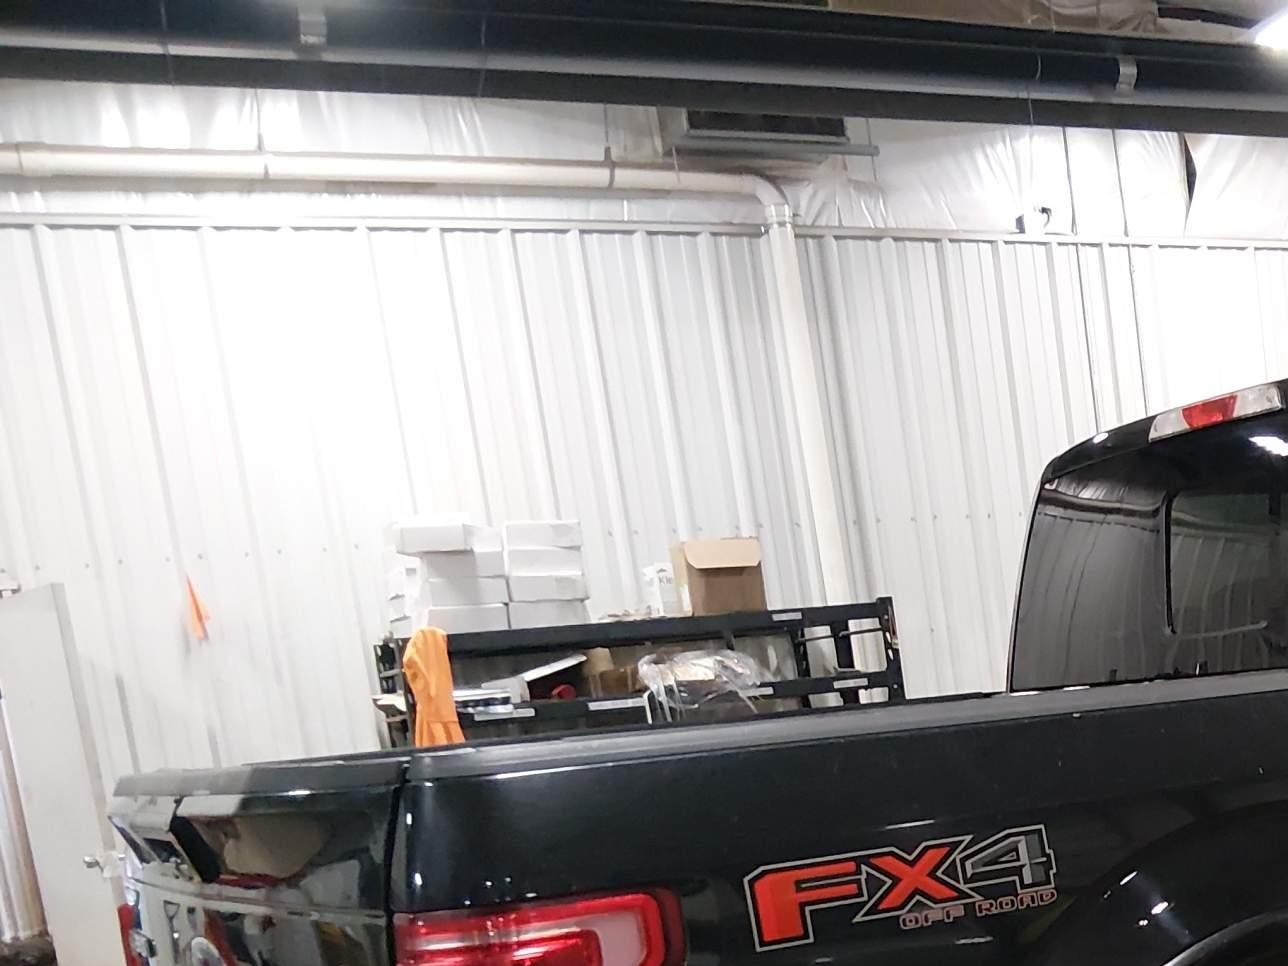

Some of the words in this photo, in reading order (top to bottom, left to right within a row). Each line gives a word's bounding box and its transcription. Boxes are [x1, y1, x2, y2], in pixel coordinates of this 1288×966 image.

[743, 824, 1056, 952] FX4
[899, 904, 965, 930] OFF
[975, 889, 1058, 917] ROAD
